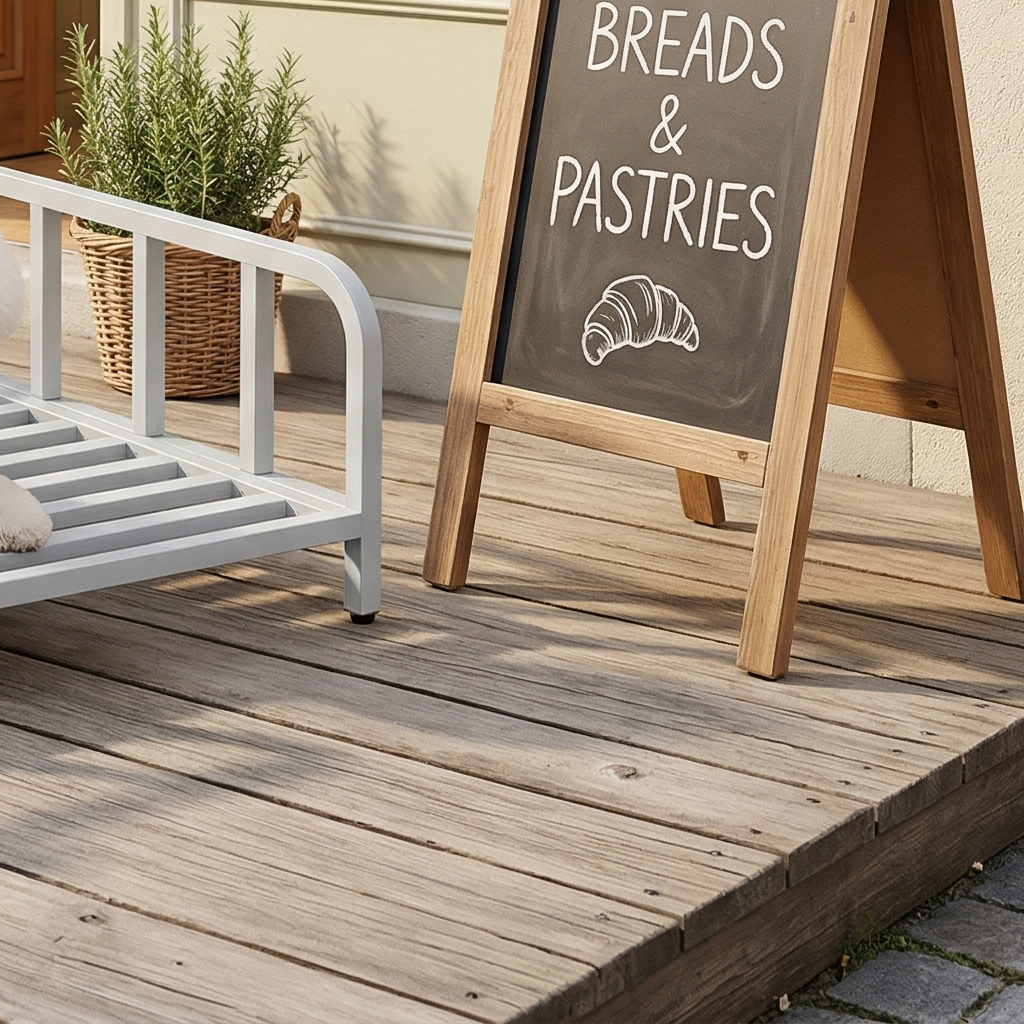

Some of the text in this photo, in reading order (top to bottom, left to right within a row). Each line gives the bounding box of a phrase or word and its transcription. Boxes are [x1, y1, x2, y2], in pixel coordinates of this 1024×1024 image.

[587, 1, 785, 90] BREADS
[649, 94, 687, 155] &
[550, 155, 775, 259] PASTRIES
